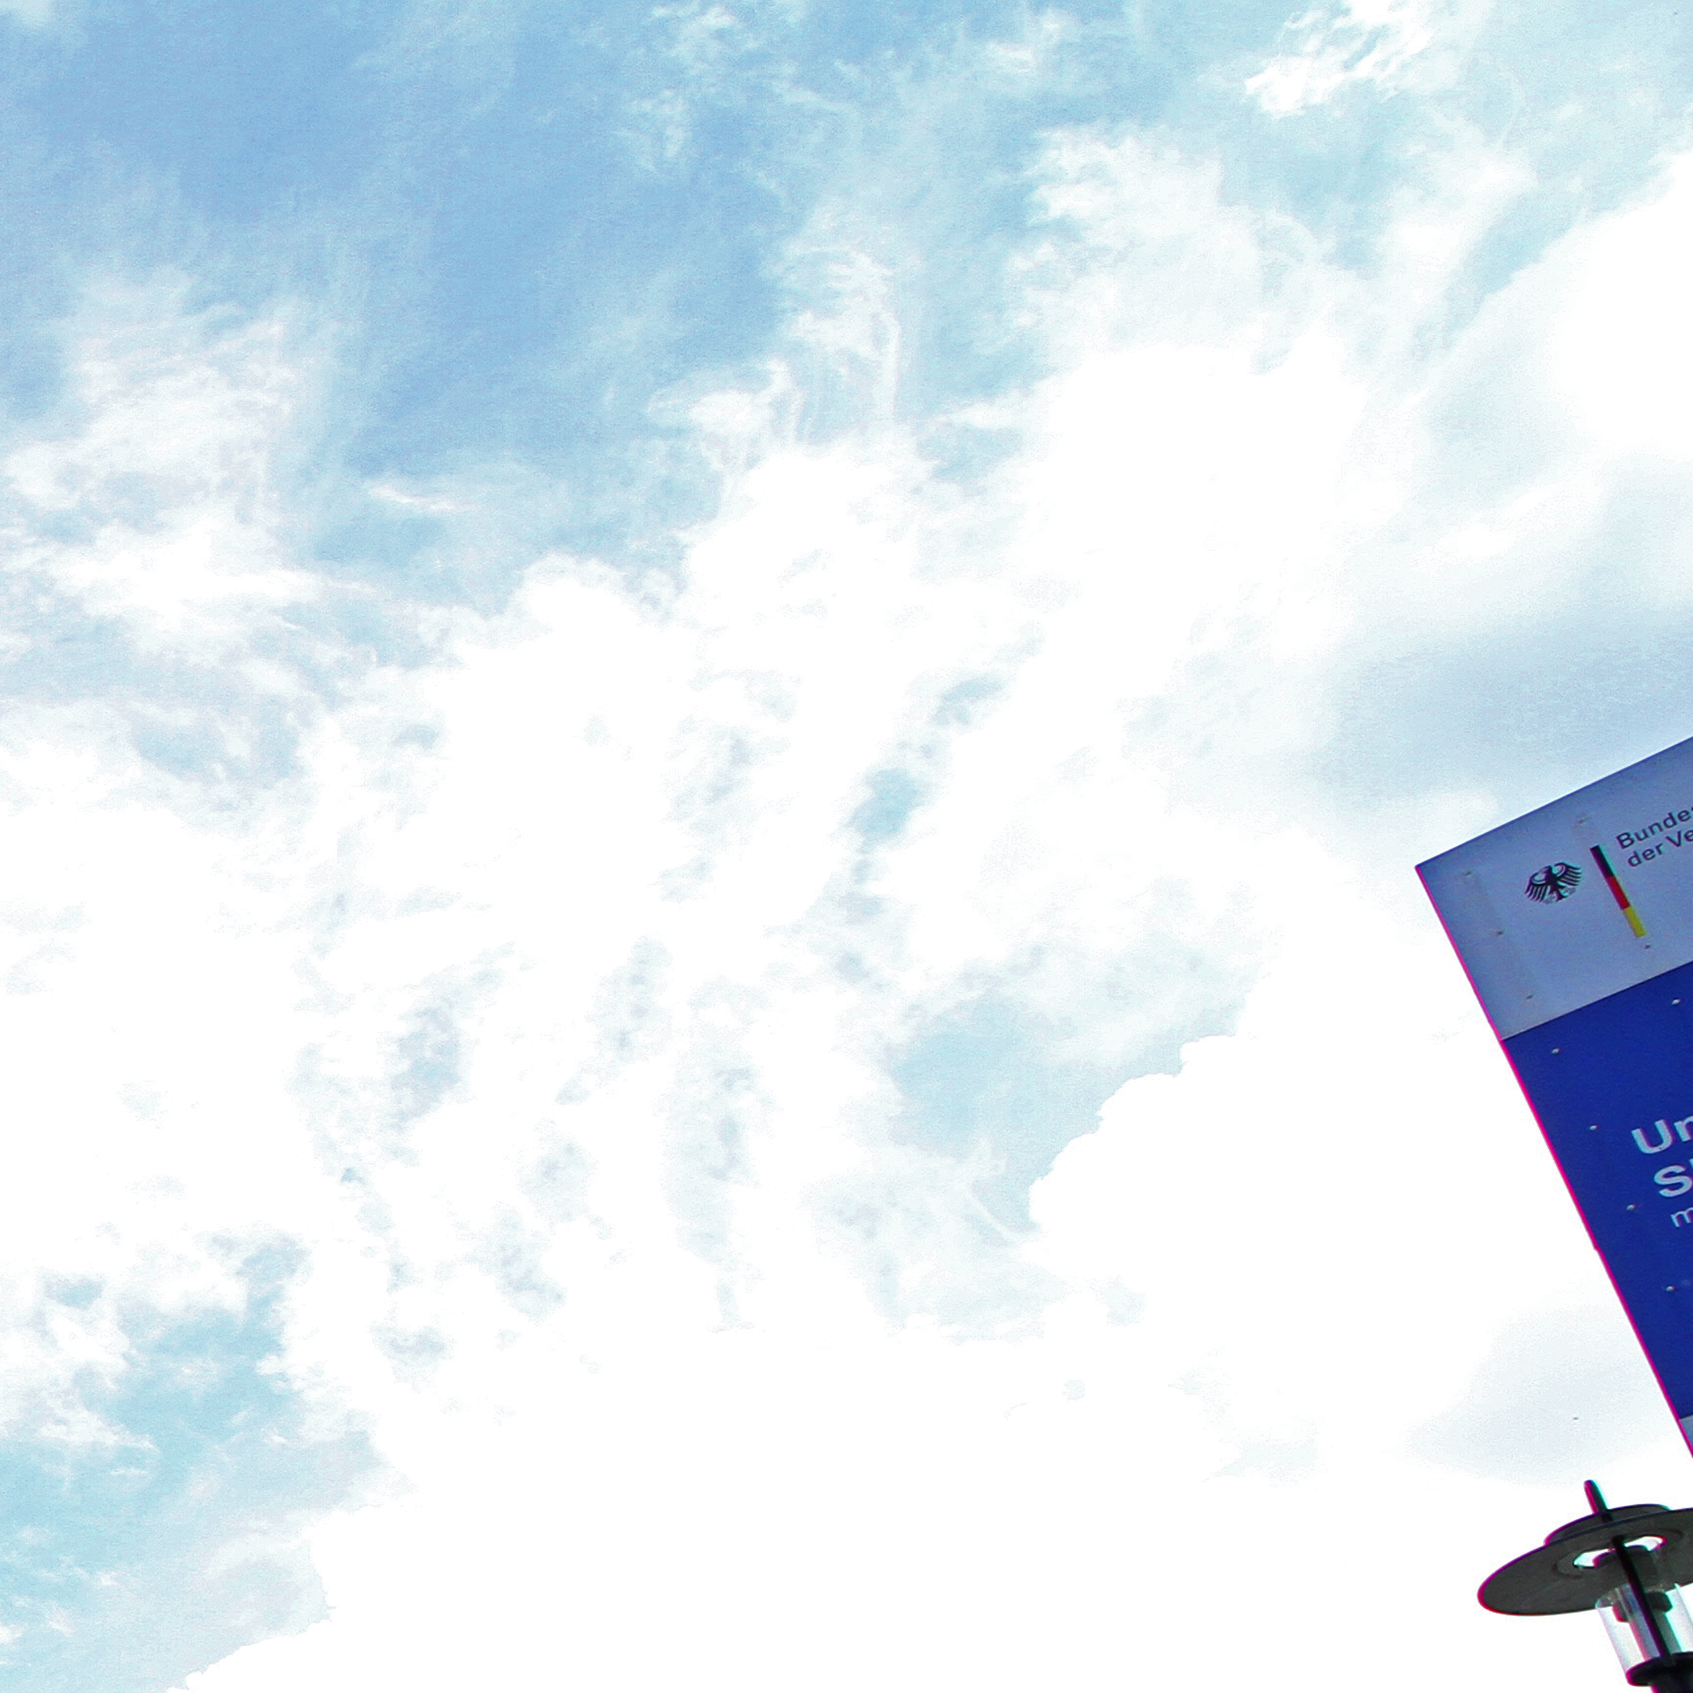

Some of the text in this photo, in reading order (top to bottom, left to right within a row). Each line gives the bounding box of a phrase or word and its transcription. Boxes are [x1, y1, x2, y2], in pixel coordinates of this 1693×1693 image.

[1616, 806, 1693, 850] Bunde
[1627, 843, 1664, 868] der
[1653, 1158, 1693, 1198] S
